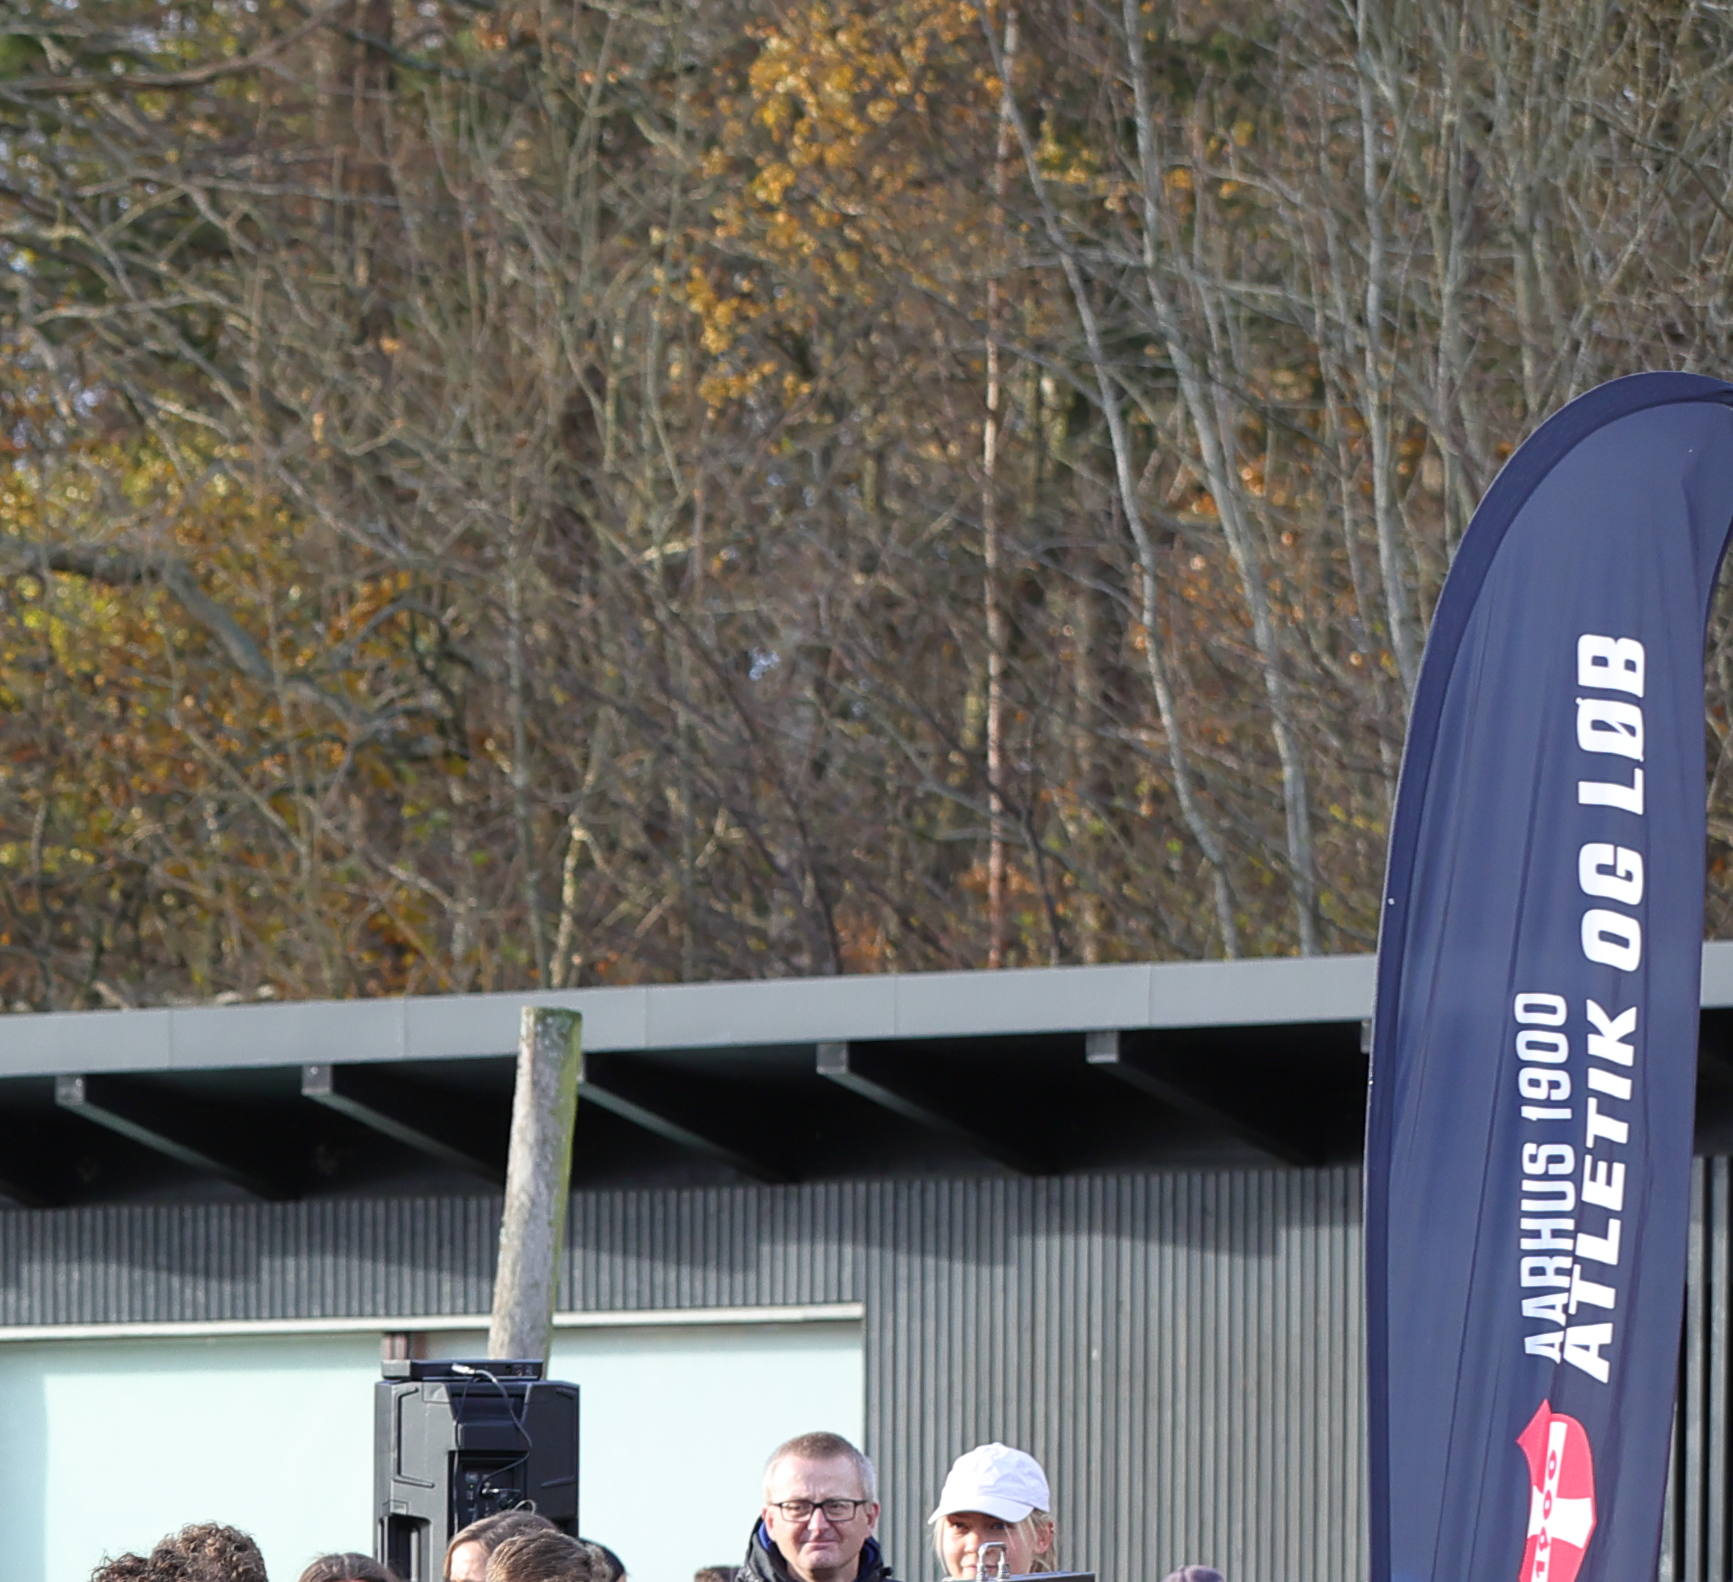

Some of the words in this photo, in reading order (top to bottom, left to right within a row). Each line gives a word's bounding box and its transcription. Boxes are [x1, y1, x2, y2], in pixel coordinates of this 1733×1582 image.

[1577, 632, 1646, 815] LØB
[1579, 841, 1645, 972] OG
[1513, 992, 1575, 1121] 1900
[1520, 1142, 1577, 1365] AARHUS
[1561, 997, 1639, 1384] ATLETIK
